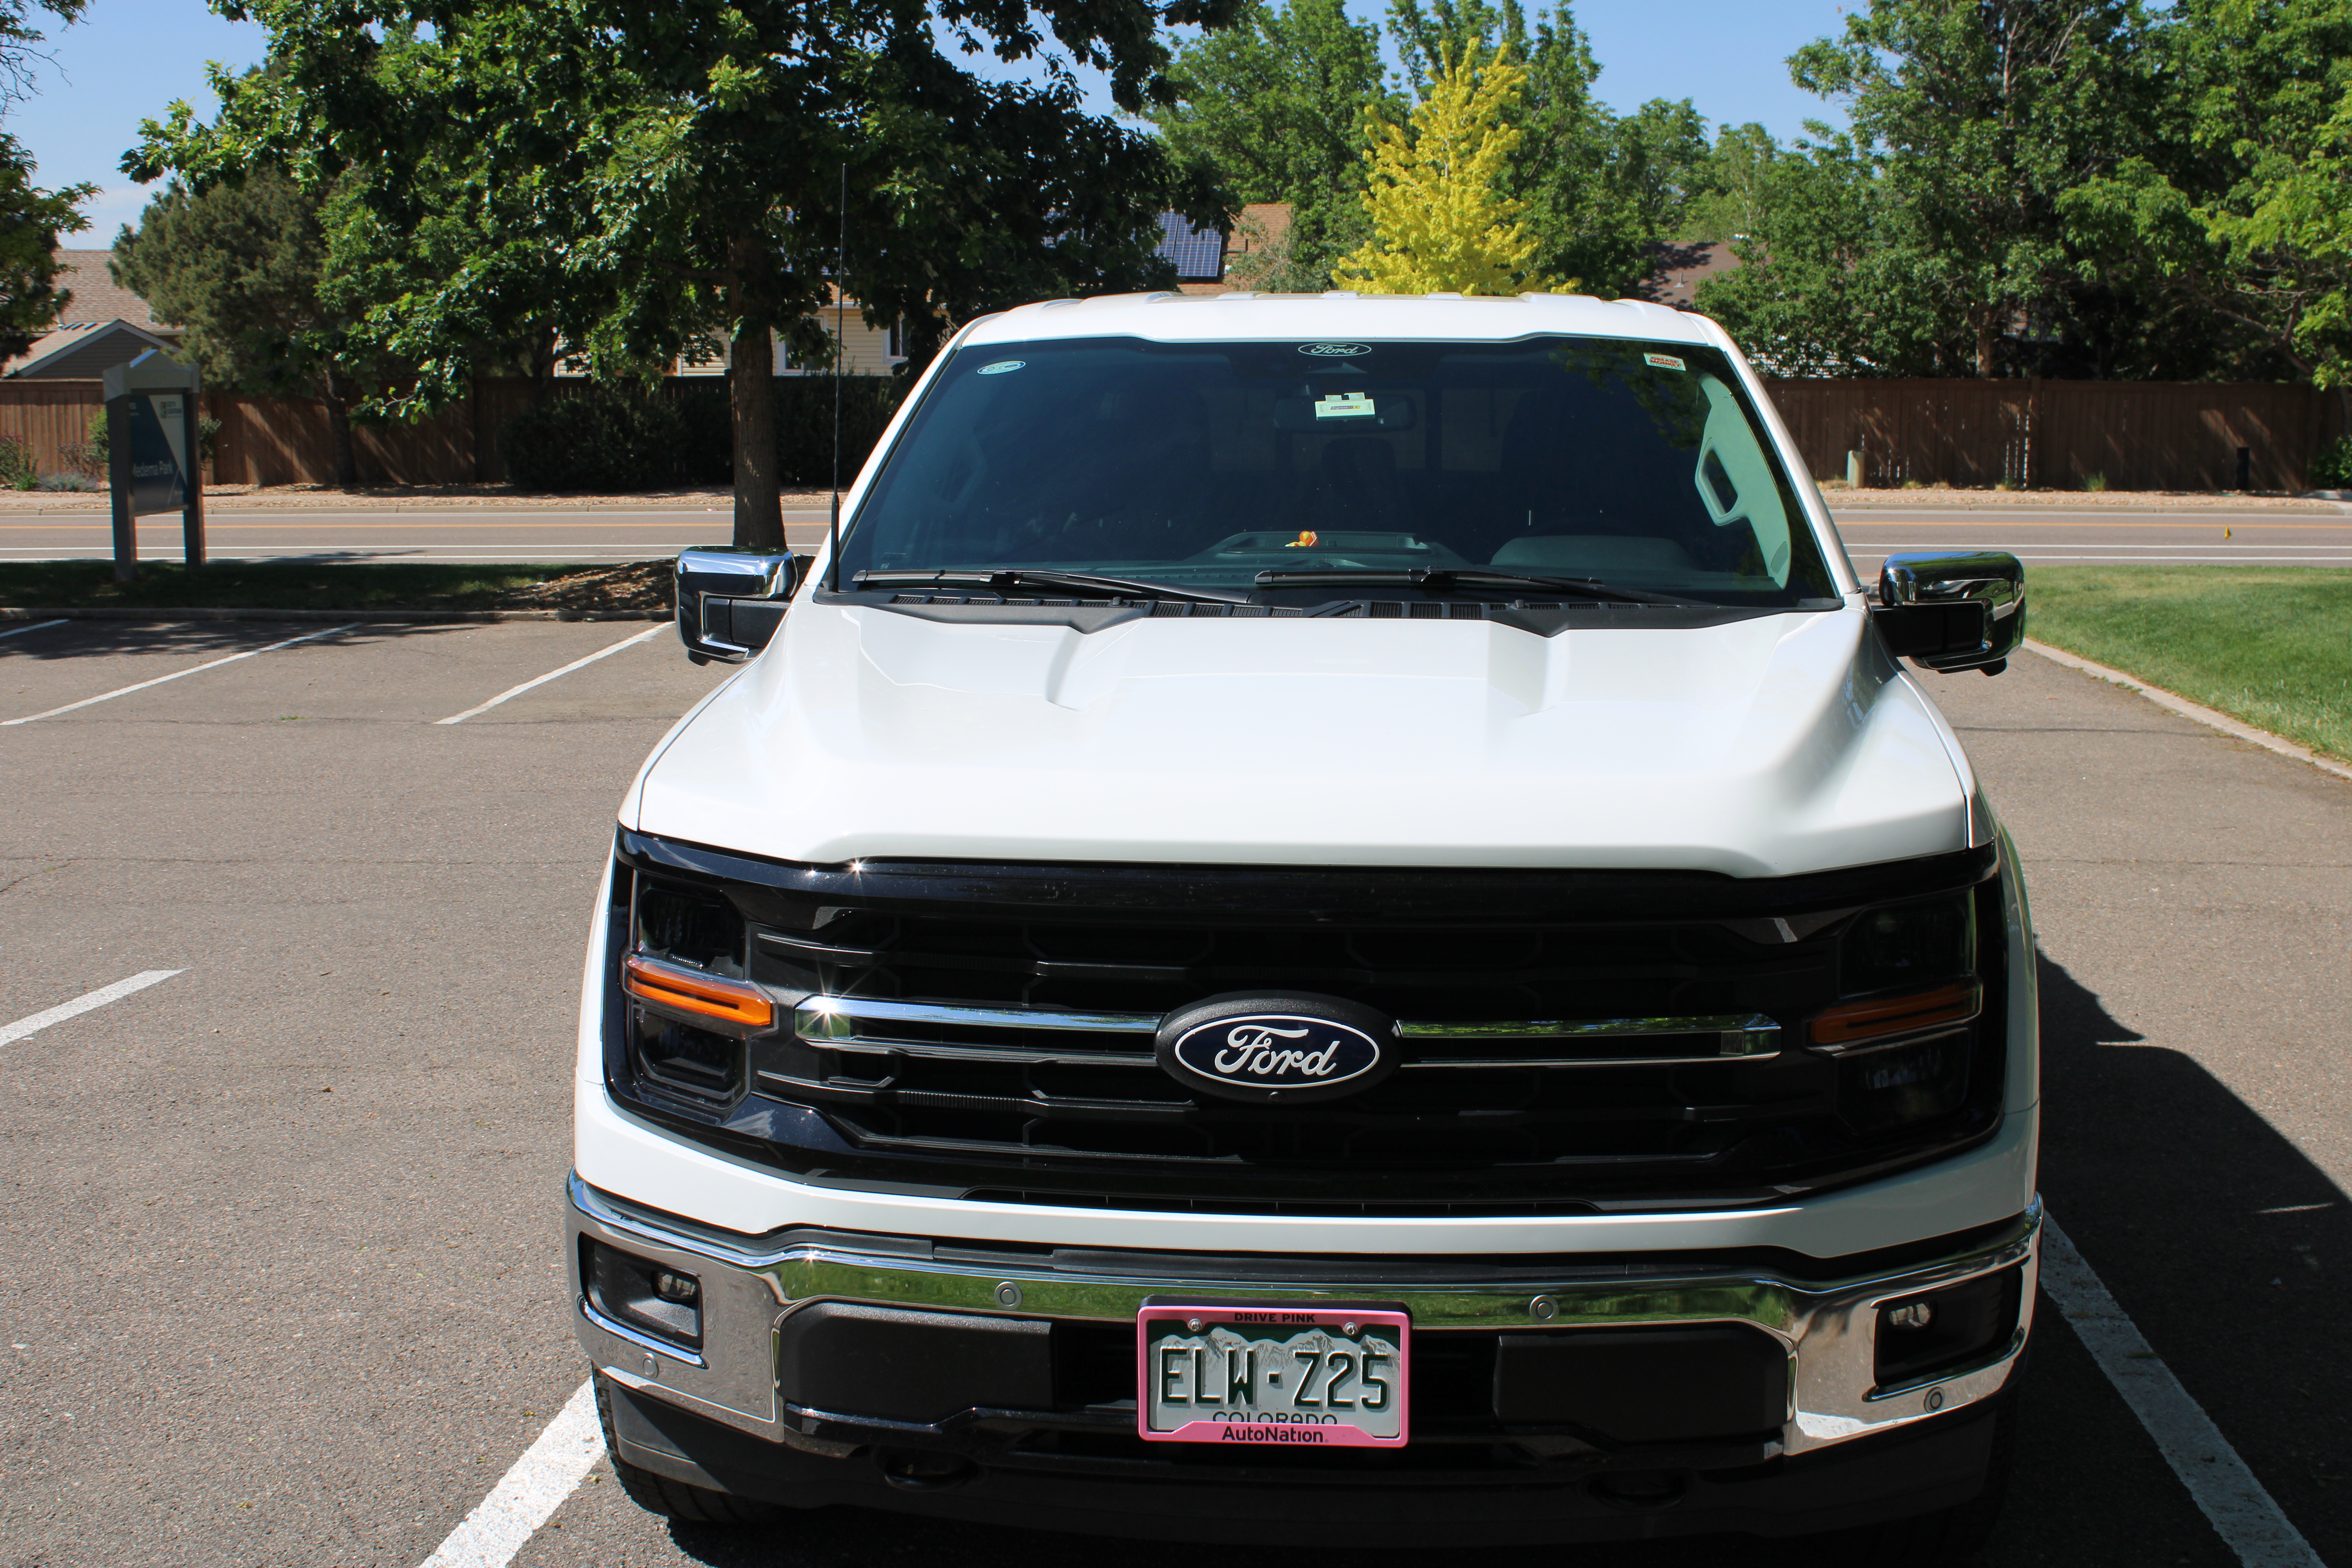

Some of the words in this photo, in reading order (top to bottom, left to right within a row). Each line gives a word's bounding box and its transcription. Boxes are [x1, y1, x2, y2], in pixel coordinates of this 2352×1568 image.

[1311, 344, 1359, 354] Ford
[158, 460, 173, 475] Park
[1215, 1025, 1340, 1075] Ford
[1235, 1313, 1276, 1322] DRIVE
[1282, 1314, 1315, 1323] PINK
[1222, 1426, 1323, 1443] AutoNation
